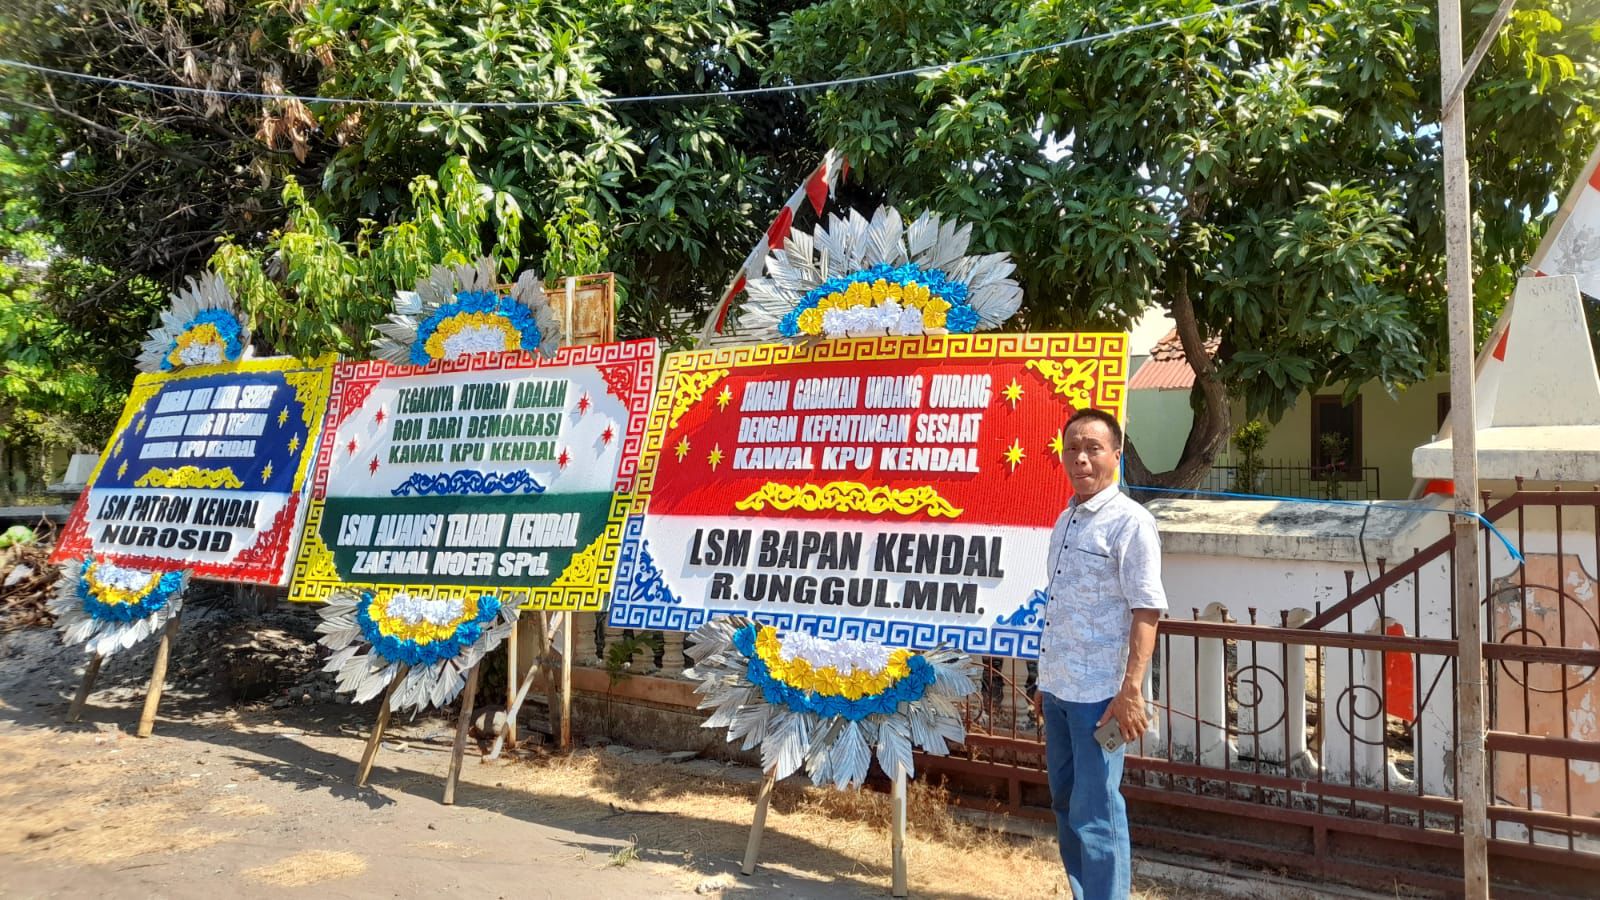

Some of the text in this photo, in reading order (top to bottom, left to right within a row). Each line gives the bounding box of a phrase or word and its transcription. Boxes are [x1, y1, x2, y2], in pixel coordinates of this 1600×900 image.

[397, 379, 568, 414] TEGAKNYA ATURAN ADALAH
[740, 373, 993, 411] JANGAN GADAIKAN UNDANG UNDANG
[392, 412, 563, 441] ROH DARI DEMOKRASI
[738, 413, 983, 443] DENGAN KEPENTINGAN SESAAT
[388, 440, 557, 464] KAWAL KPU KENDAL
[733, 446, 980, 472] KAWAL KPU KENDAL
[96, 495, 260, 529] LSM PATRON KENDAL
[99, 524, 233, 553] NUROSID
[337, 514, 376, 546] LSM
[445, 513, 506, 547] TAJAM
[506, 512, 580, 547] KENDAL
[351, 551, 429, 575] ZAENAL
[432, 551, 496, 576] NOER
[689, 528, 1005, 578] LSM BAPAN KENDAL
[710, 572, 985, 615] R.UNGGUL.MM.
